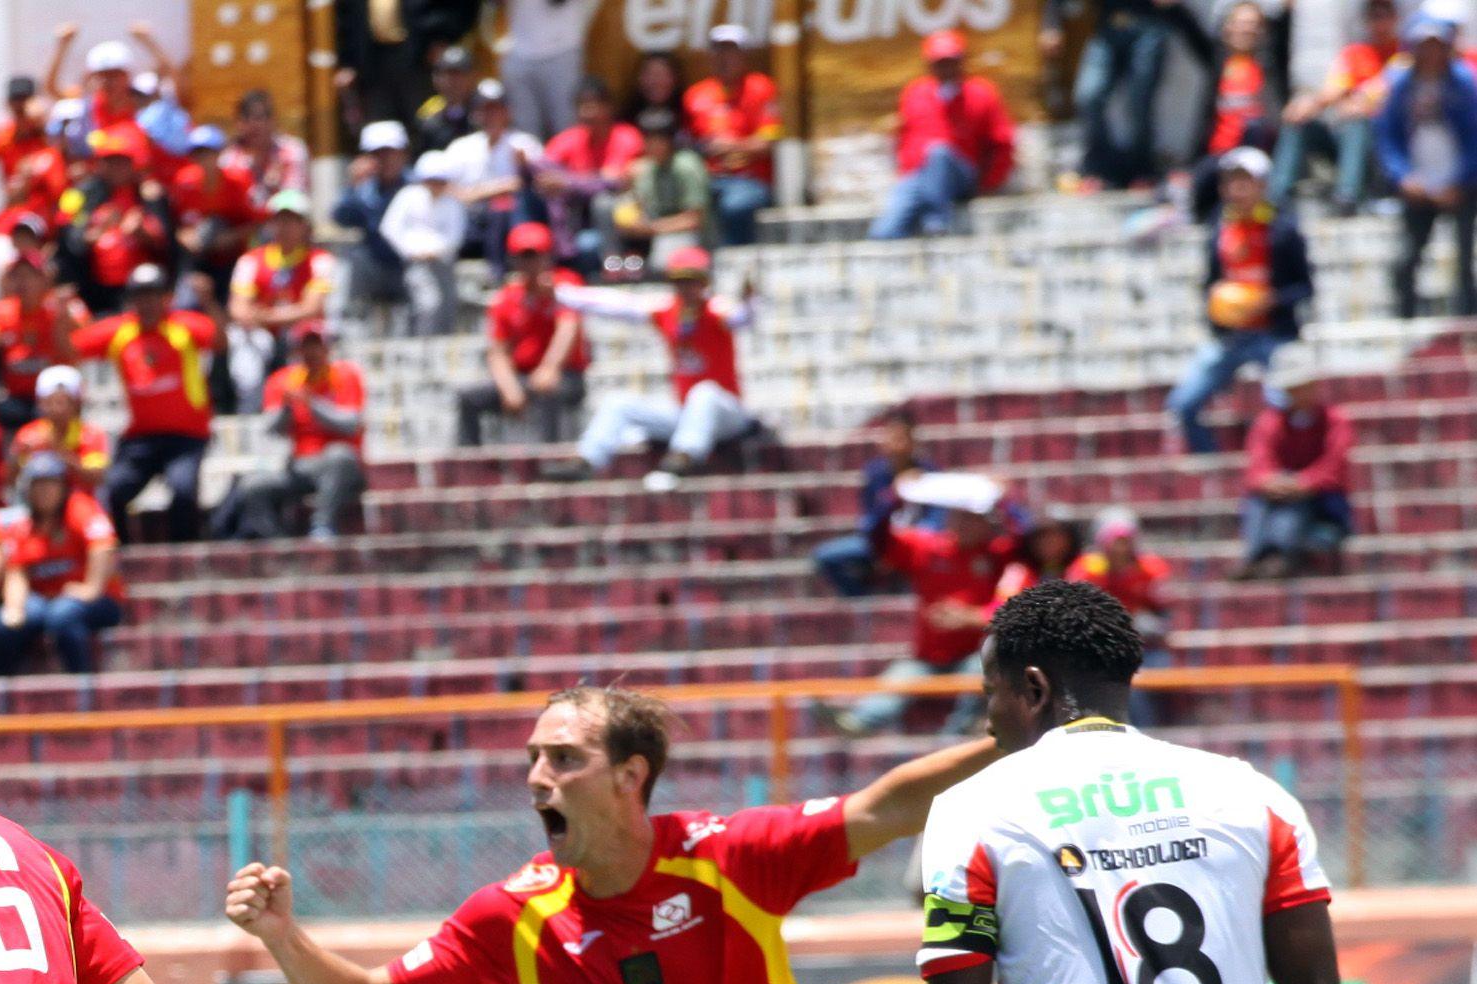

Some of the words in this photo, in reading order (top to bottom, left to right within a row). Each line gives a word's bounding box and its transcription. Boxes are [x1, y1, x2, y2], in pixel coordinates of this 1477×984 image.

[1036, 772, 1185, 829] grün
[1128, 815, 1190, 836] mobile
[1088, 837, 1208, 871] TECHGOLDEN
